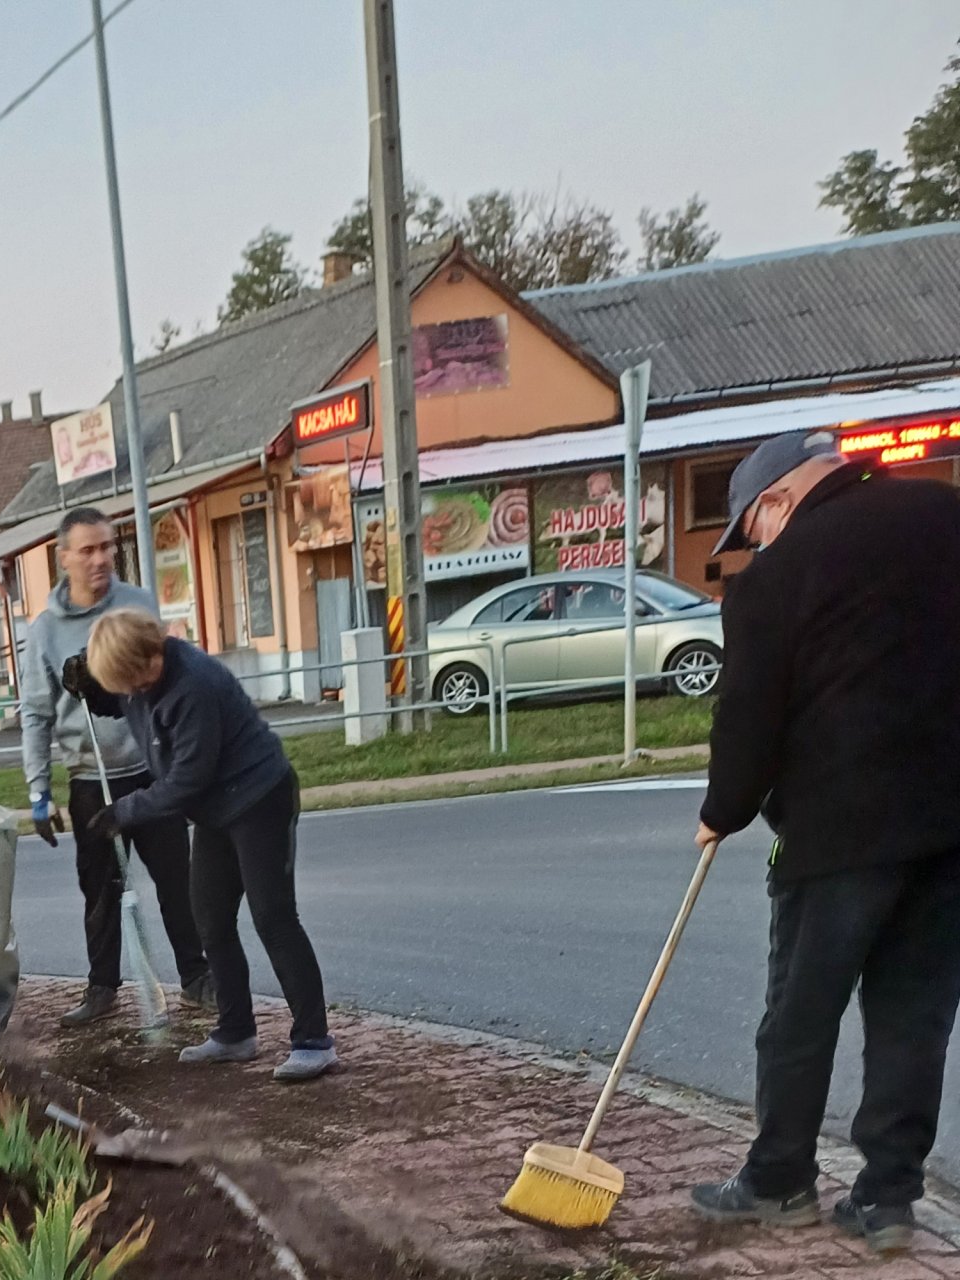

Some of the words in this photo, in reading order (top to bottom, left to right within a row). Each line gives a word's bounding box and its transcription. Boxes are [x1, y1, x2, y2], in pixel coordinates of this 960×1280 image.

[299, 406, 334, 438] KACSA
[335, 397, 356, 427] HÁJ
[551, 498, 647, 534] HAJDUSI
